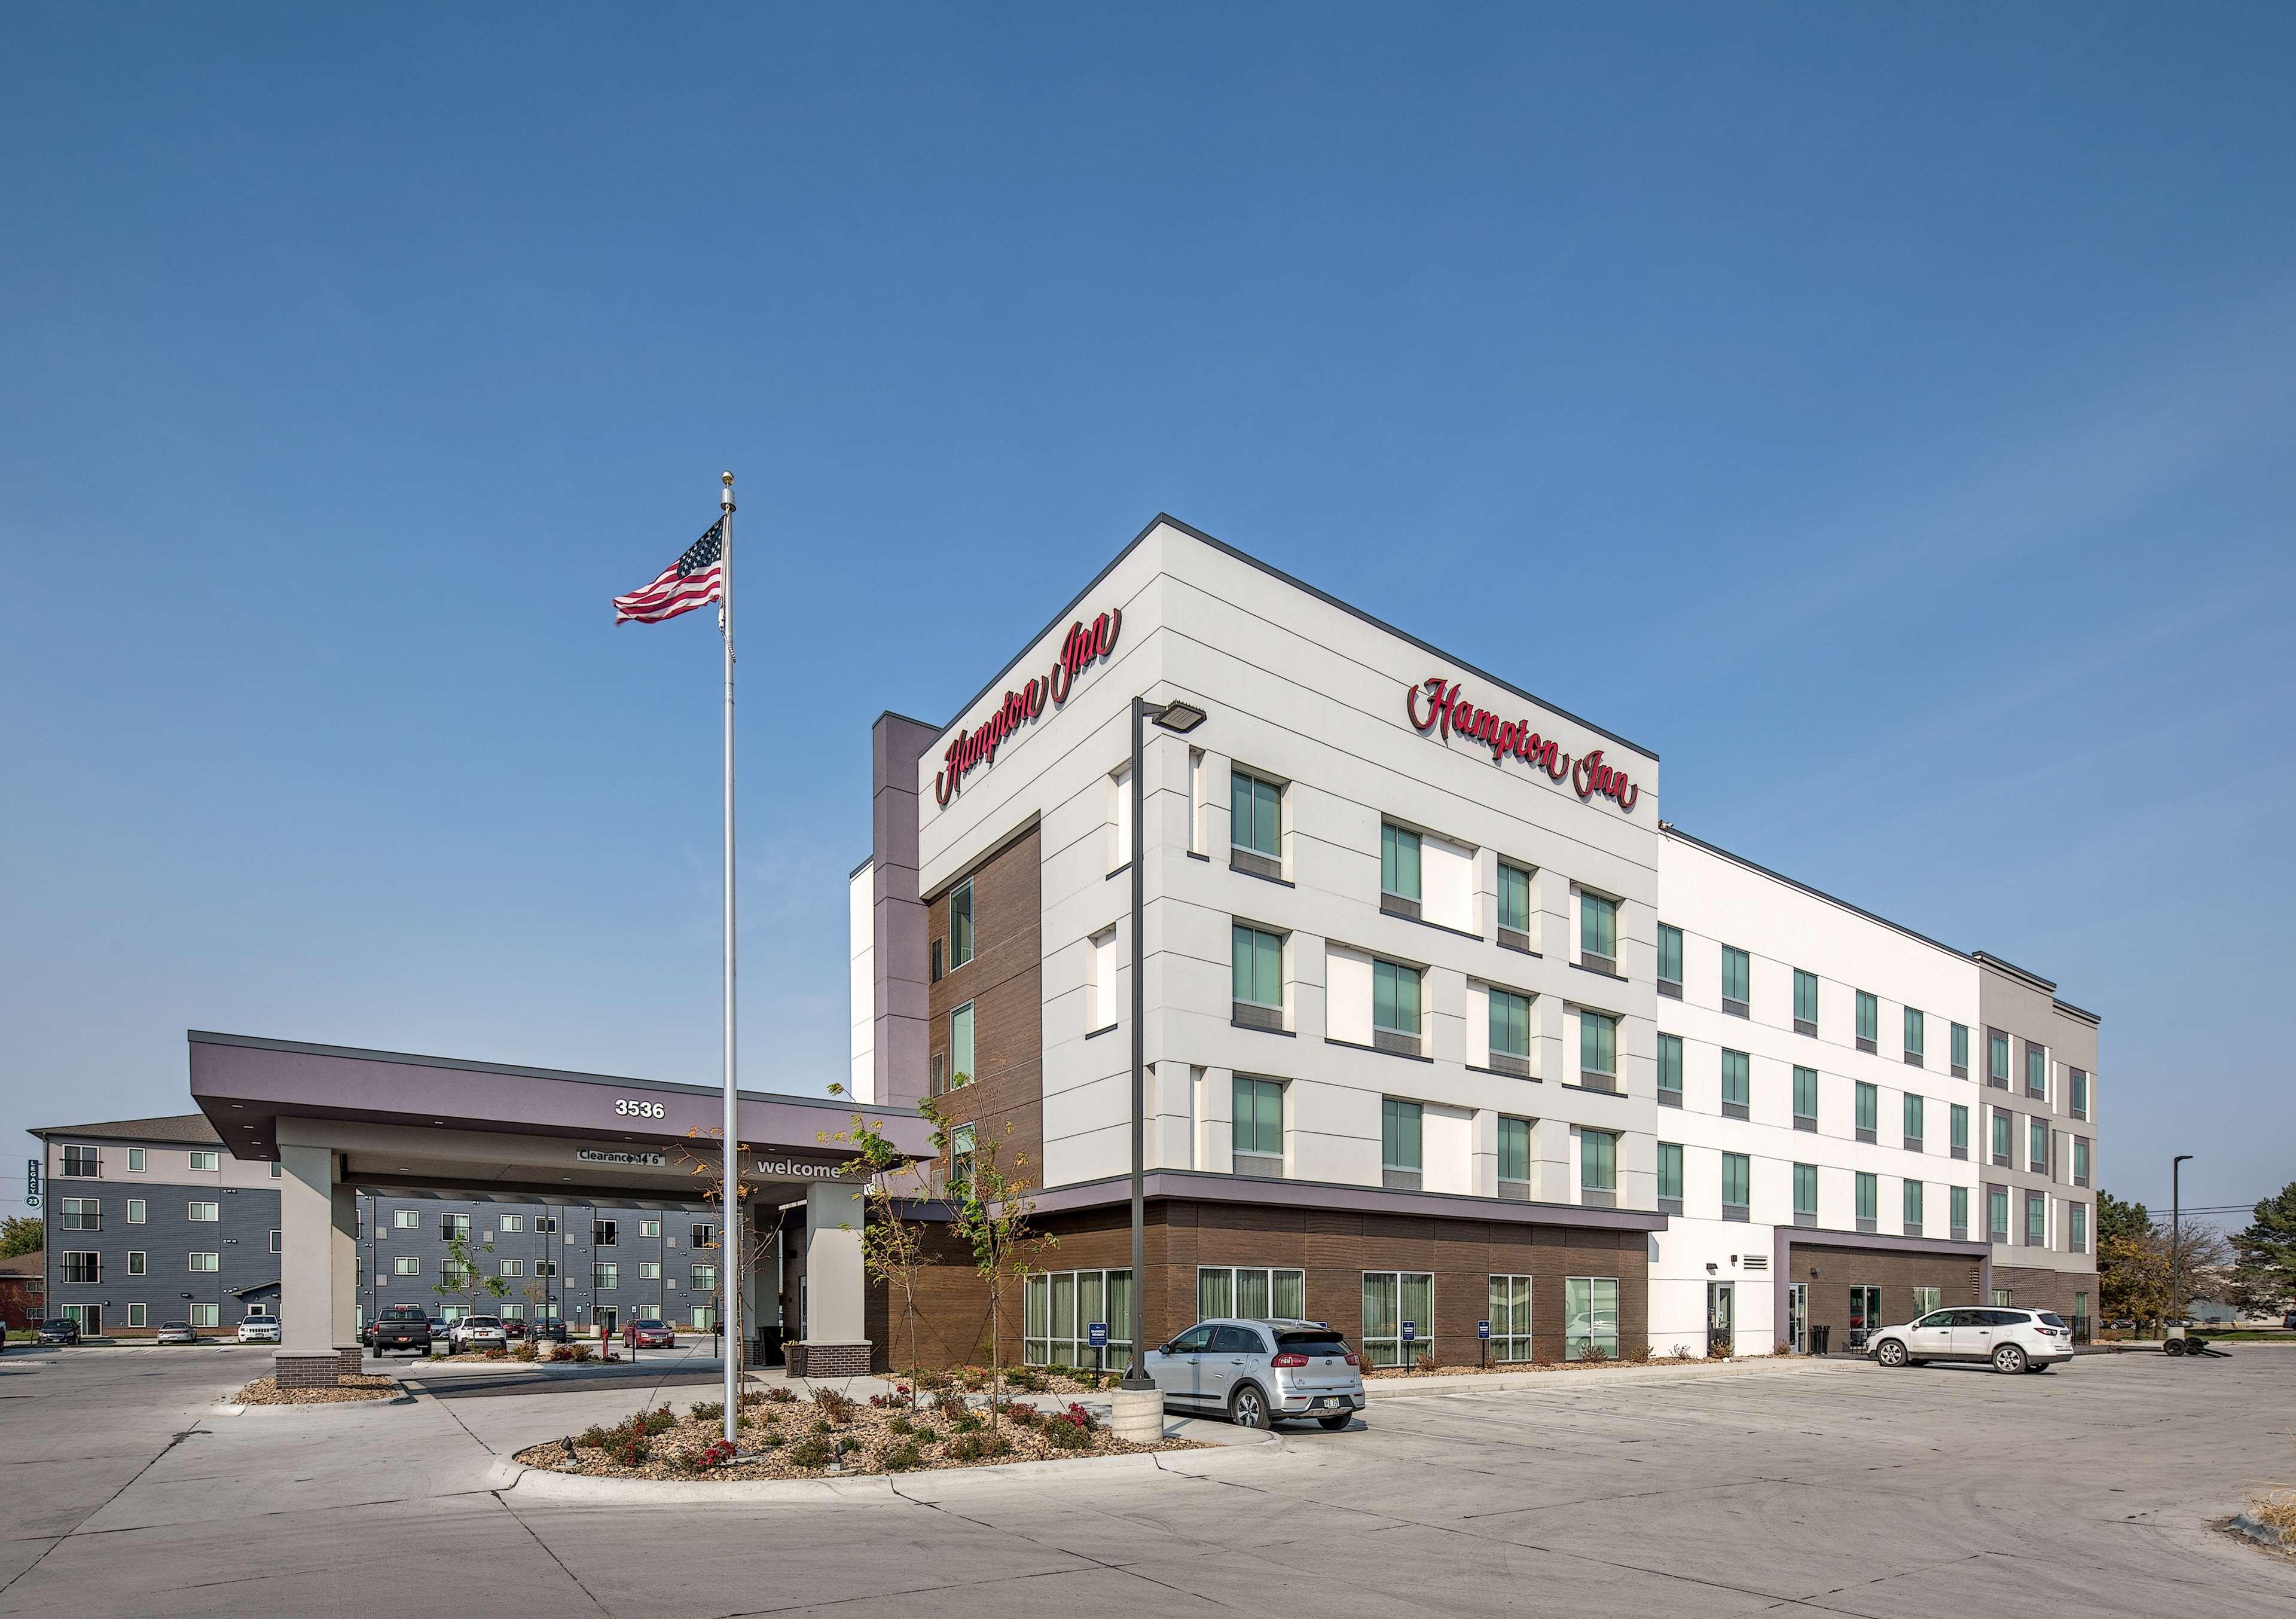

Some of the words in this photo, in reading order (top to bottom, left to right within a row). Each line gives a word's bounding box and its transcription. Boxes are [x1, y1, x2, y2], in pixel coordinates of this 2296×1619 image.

[936, 676, 1048, 805] Hampton
[1051, 608, 1122, 704] Inn
[1407, 678, 1570, 780] Hampton
[1573, 750, 1638, 808] Inn
[615, 1099, 665, 1119] 3536
[579, 1149, 633, 1163] Clearance
[757, 1159, 841, 1178] welcome
